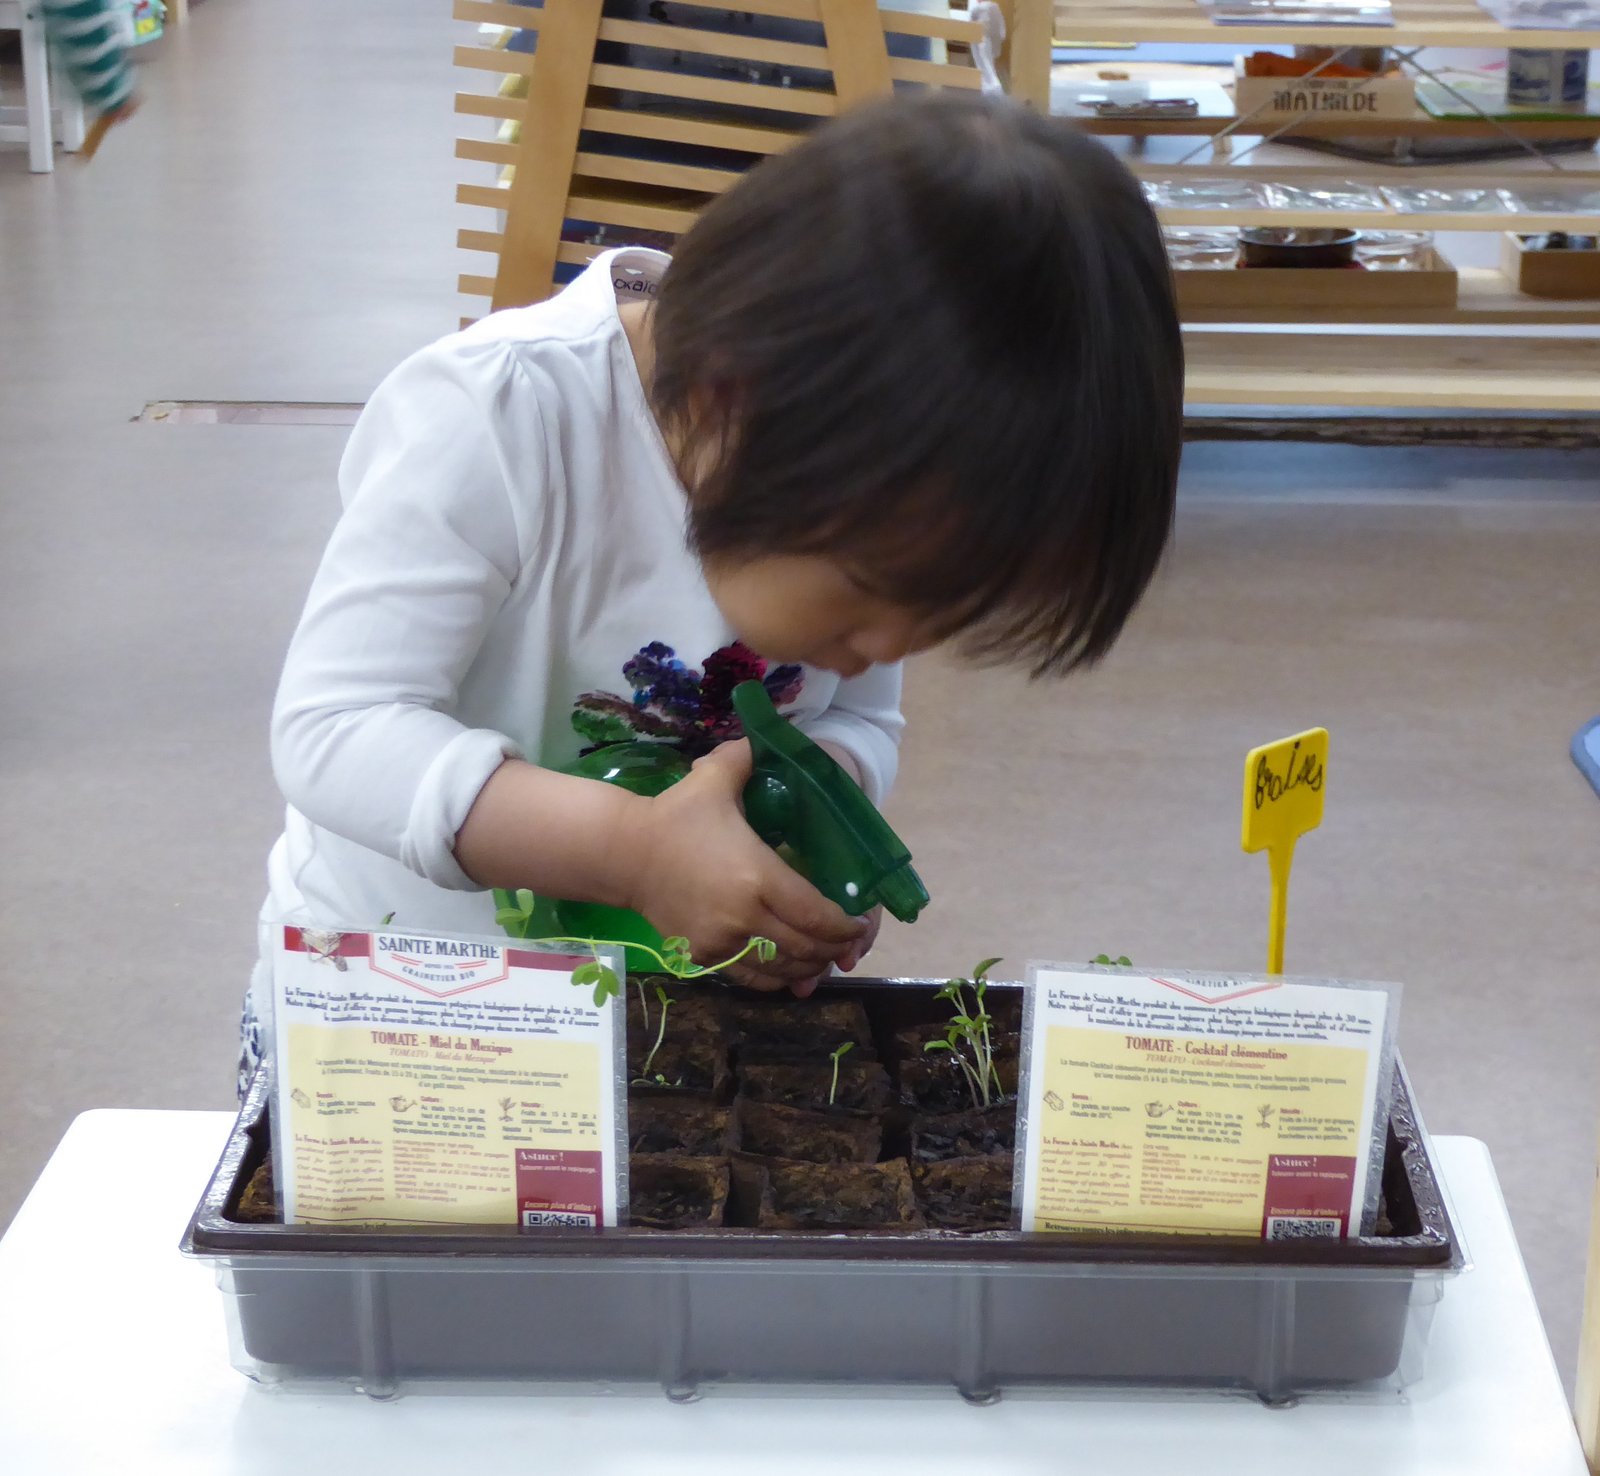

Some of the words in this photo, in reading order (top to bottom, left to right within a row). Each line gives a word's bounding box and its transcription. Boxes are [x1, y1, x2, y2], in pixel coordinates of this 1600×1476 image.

[380, 937, 431, 955] SAINTE
[435, 941, 500, 959] MARTHE
[371, 1031, 419, 1047] TOMATE
[430, 1035, 451, 1049] Miel
[454, 1037, 467, 1050] du
[470, 1038, 513, 1056] Mexique
[1125, 1036, 1174, 1053] TOMATE
[1185, 1041, 1229, 1057] Cocktail
